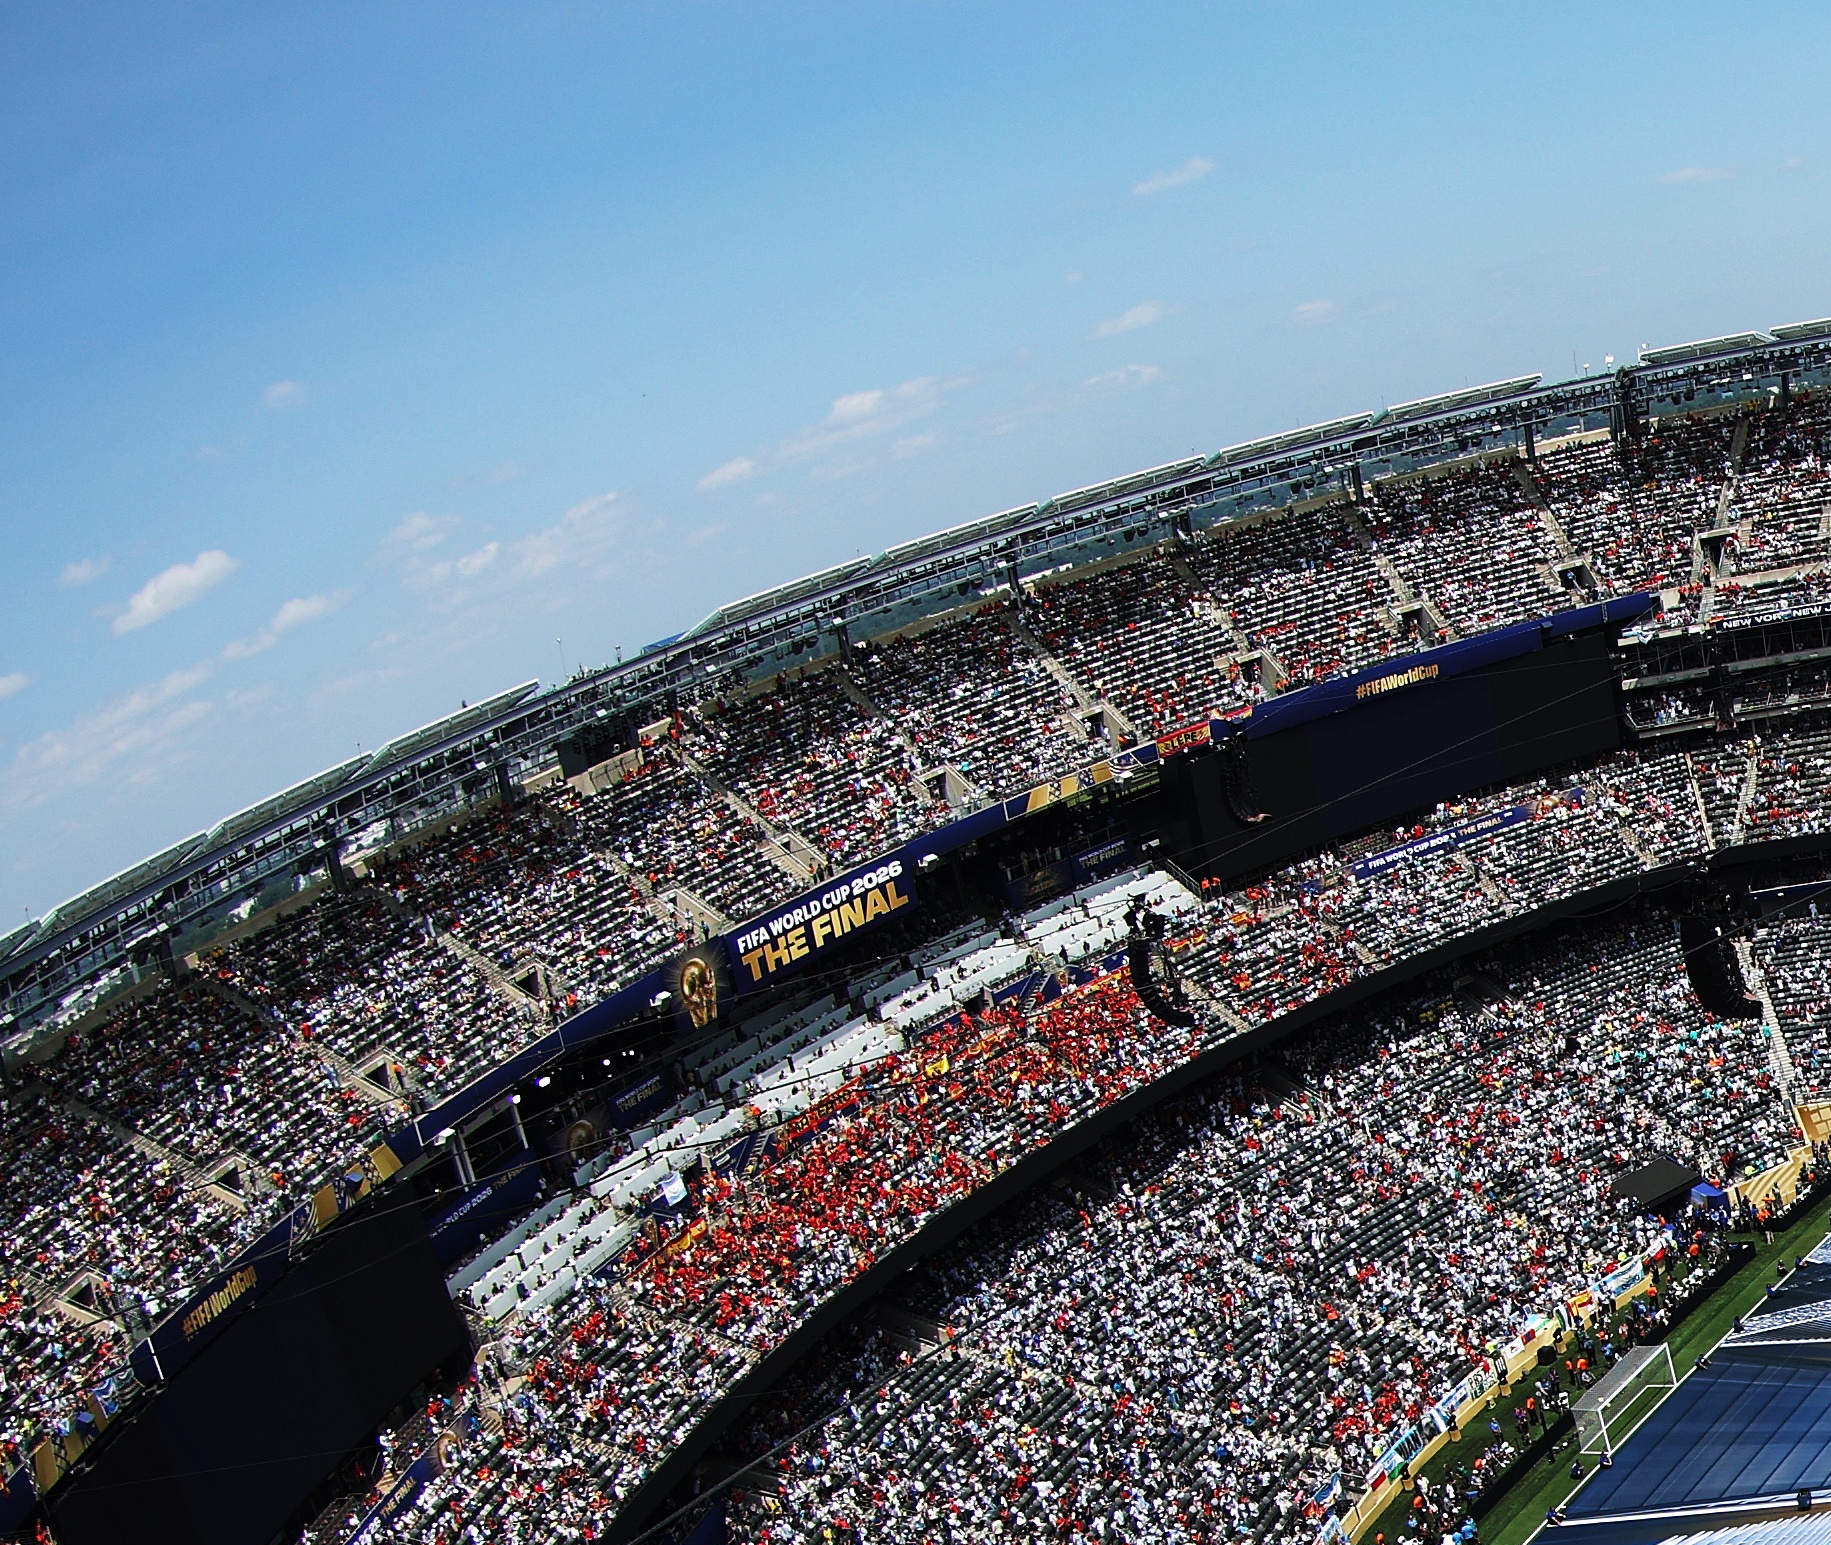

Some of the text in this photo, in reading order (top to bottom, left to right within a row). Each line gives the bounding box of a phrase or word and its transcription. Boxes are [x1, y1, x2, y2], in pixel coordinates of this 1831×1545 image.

[1722, 617, 1752, 628] NEW
[1791, 605, 1822, 617] NEW
[1355, 664, 1440, 700] #FIFAWorldCup
[1367, 859, 1384, 870] FIFA
[1458, 826, 1475, 837] THE
[1476, 816, 1503, 832] FINAL
[737, 860, 903, 954] FIFA WORLD CUP 2026
[742, 882, 910, 982] THE FINAL
[183, 1265, 258, 1334] #FIFAWorldCup
[381, 1493, 399, 1518] THE
